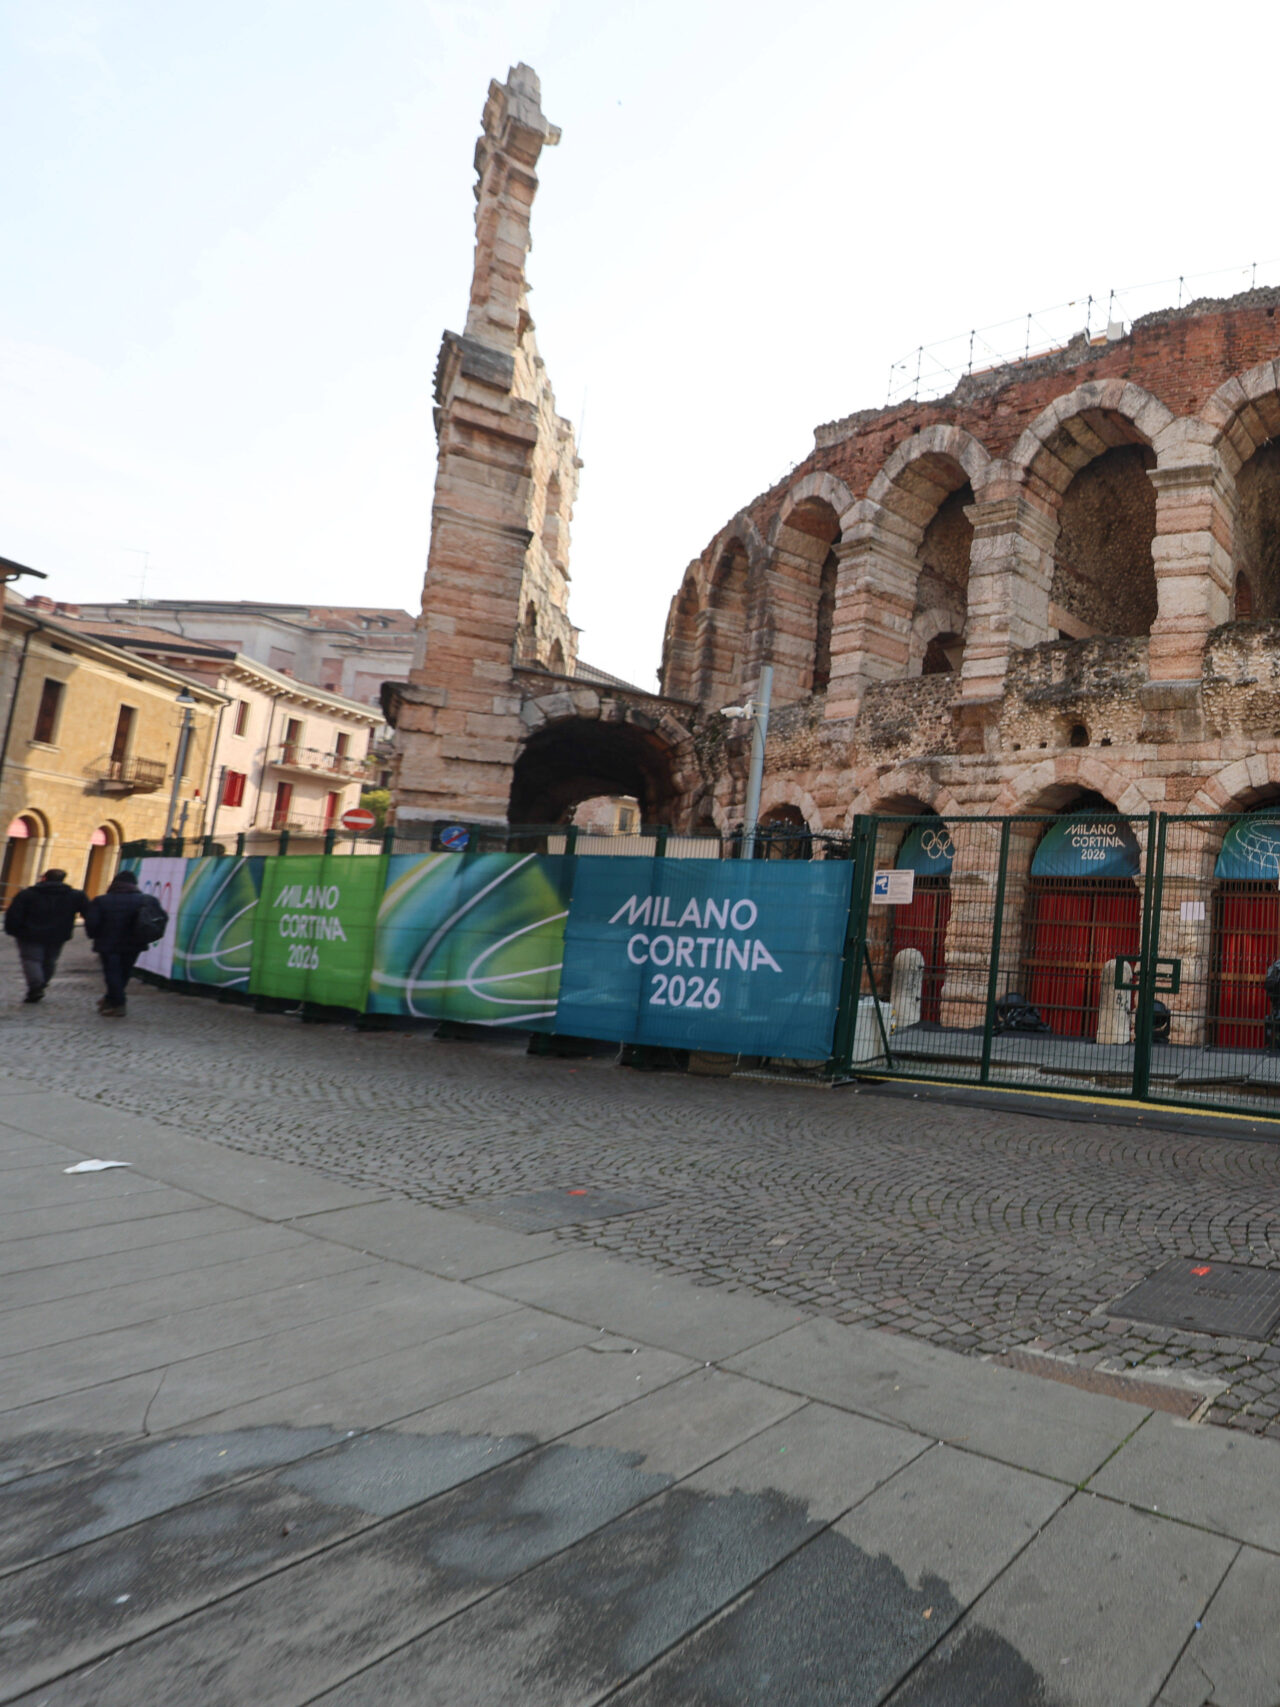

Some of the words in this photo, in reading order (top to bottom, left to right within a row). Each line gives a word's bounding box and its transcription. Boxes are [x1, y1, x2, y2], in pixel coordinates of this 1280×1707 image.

[1064, 823, 1117, 836] MILANO
[1072, 836, 1126, 848] CORTINA
[1081, 848, 1106, 860] 2026
[272, 884, 340, 910] MILANO
[608, 894, 758, 931] MILANO
[279, 913, 348, 942] CORTINA
[286, 943, 320, 970] 2026
[627, 933, 783, 973] CORTINA
[649, 973, 721, 1010] 2026
